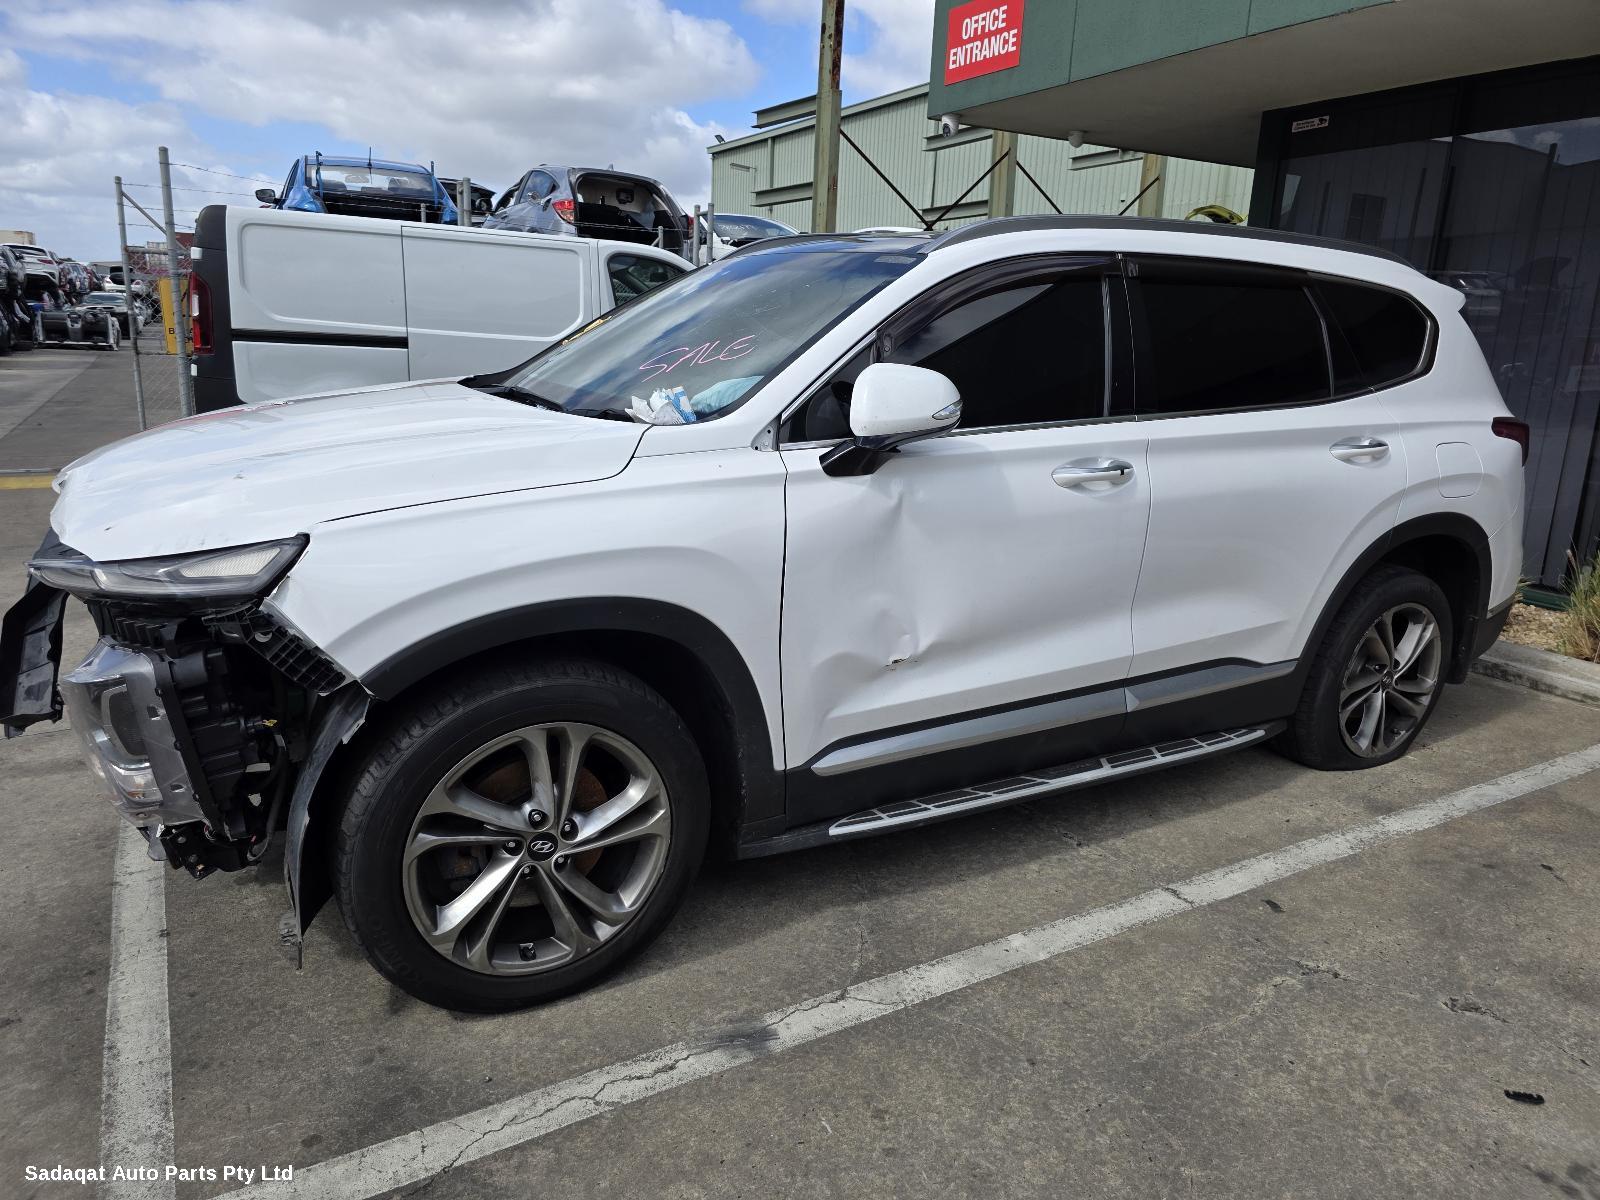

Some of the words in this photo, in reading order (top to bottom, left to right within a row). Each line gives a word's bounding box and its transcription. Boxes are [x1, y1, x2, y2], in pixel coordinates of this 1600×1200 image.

[961, 5, 1008, 40] OFFICE
[948, 28, 1018, 70] ENTRANCE
[639, 334, 757, 383] SALE
